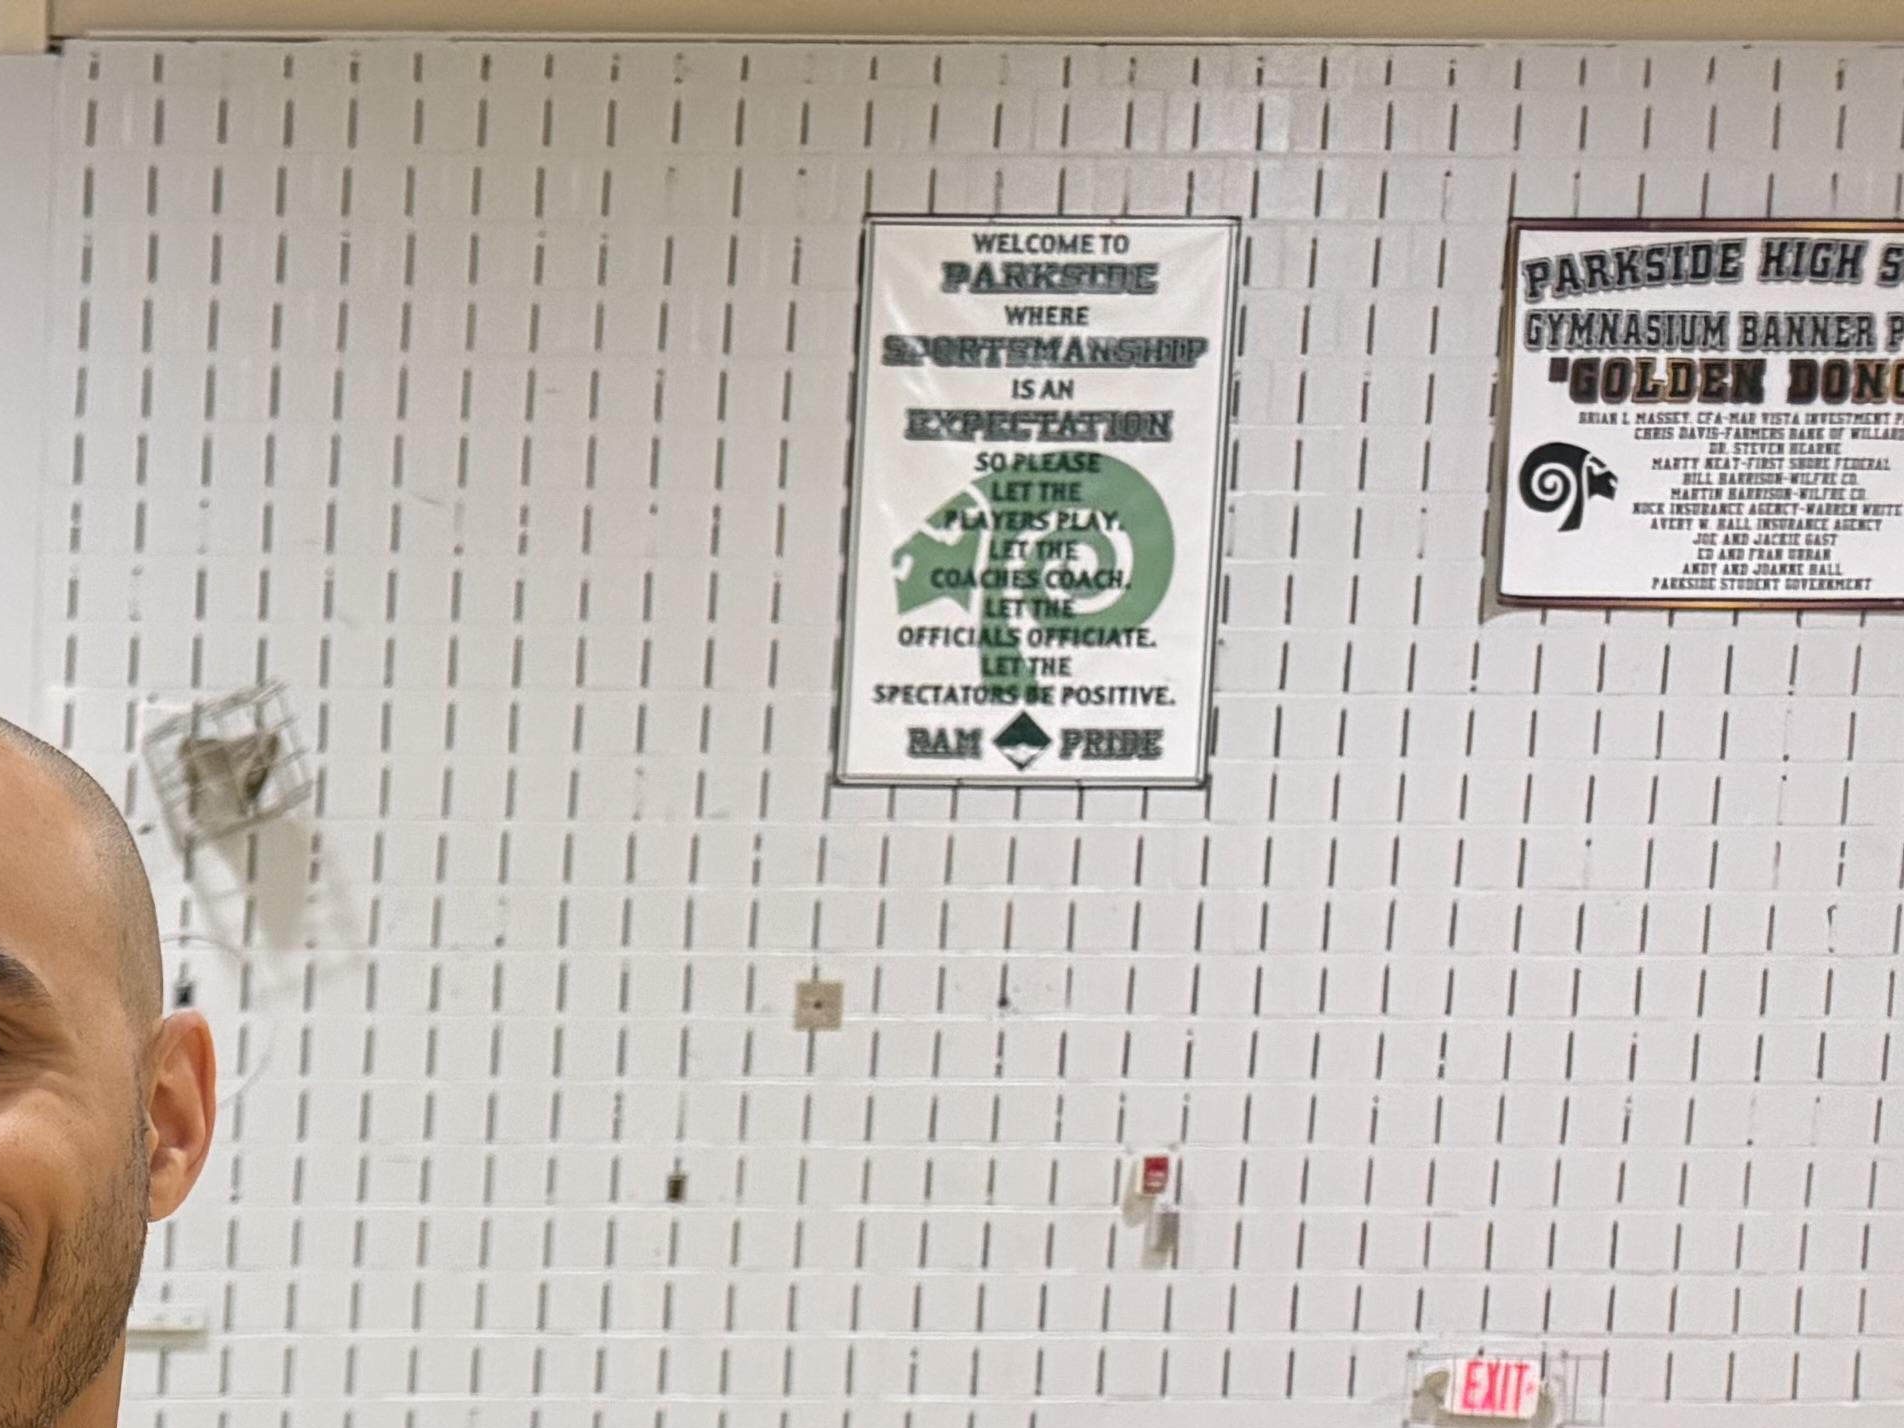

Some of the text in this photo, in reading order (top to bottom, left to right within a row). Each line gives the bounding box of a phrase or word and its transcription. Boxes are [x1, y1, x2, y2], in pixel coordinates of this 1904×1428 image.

[973, 234, 1129, 254] WELCOME TO
[942, 262, 1159, 294] PARKSIDE
[1523, 238, 1746, 302] PARKSIDE
[1759, 237, 1868, 283] HIGH
[1006, 307, 1089, 325] WHERE
[1524, 309, 1730, 350] GYMNASIUM
[1738, 311, 1876, 351] BANNER
[882, 336, 1207, 368] SPORTSMANSHIP
[1013, 380, 1073, 399] IS AN
[904, 409, 1173, 441] EXPECTATION
[976, 453, 1101, 473] SO PLEASE
[992, 482, 1082, 501] LET THE
[944, 511, 1049, 530] PLAYERS
[989, 540, 1079, 560] LET THE
[931, 569, 1038, 589] COACHES
[985, 599, 1074, 619] LET THE
[898, 627, 1156, 648] OFFICIALS OFFICIATE.
[981, 657, 1072, 676] LET THE
[873, 686, 1022, 705] SPECTATORS
[1062, 686, 1175, 706] POSITIVE.
[907, 728, 1163, 759] RAM PRIDE
[1462, 1361, 1531, 1412] EXIT
